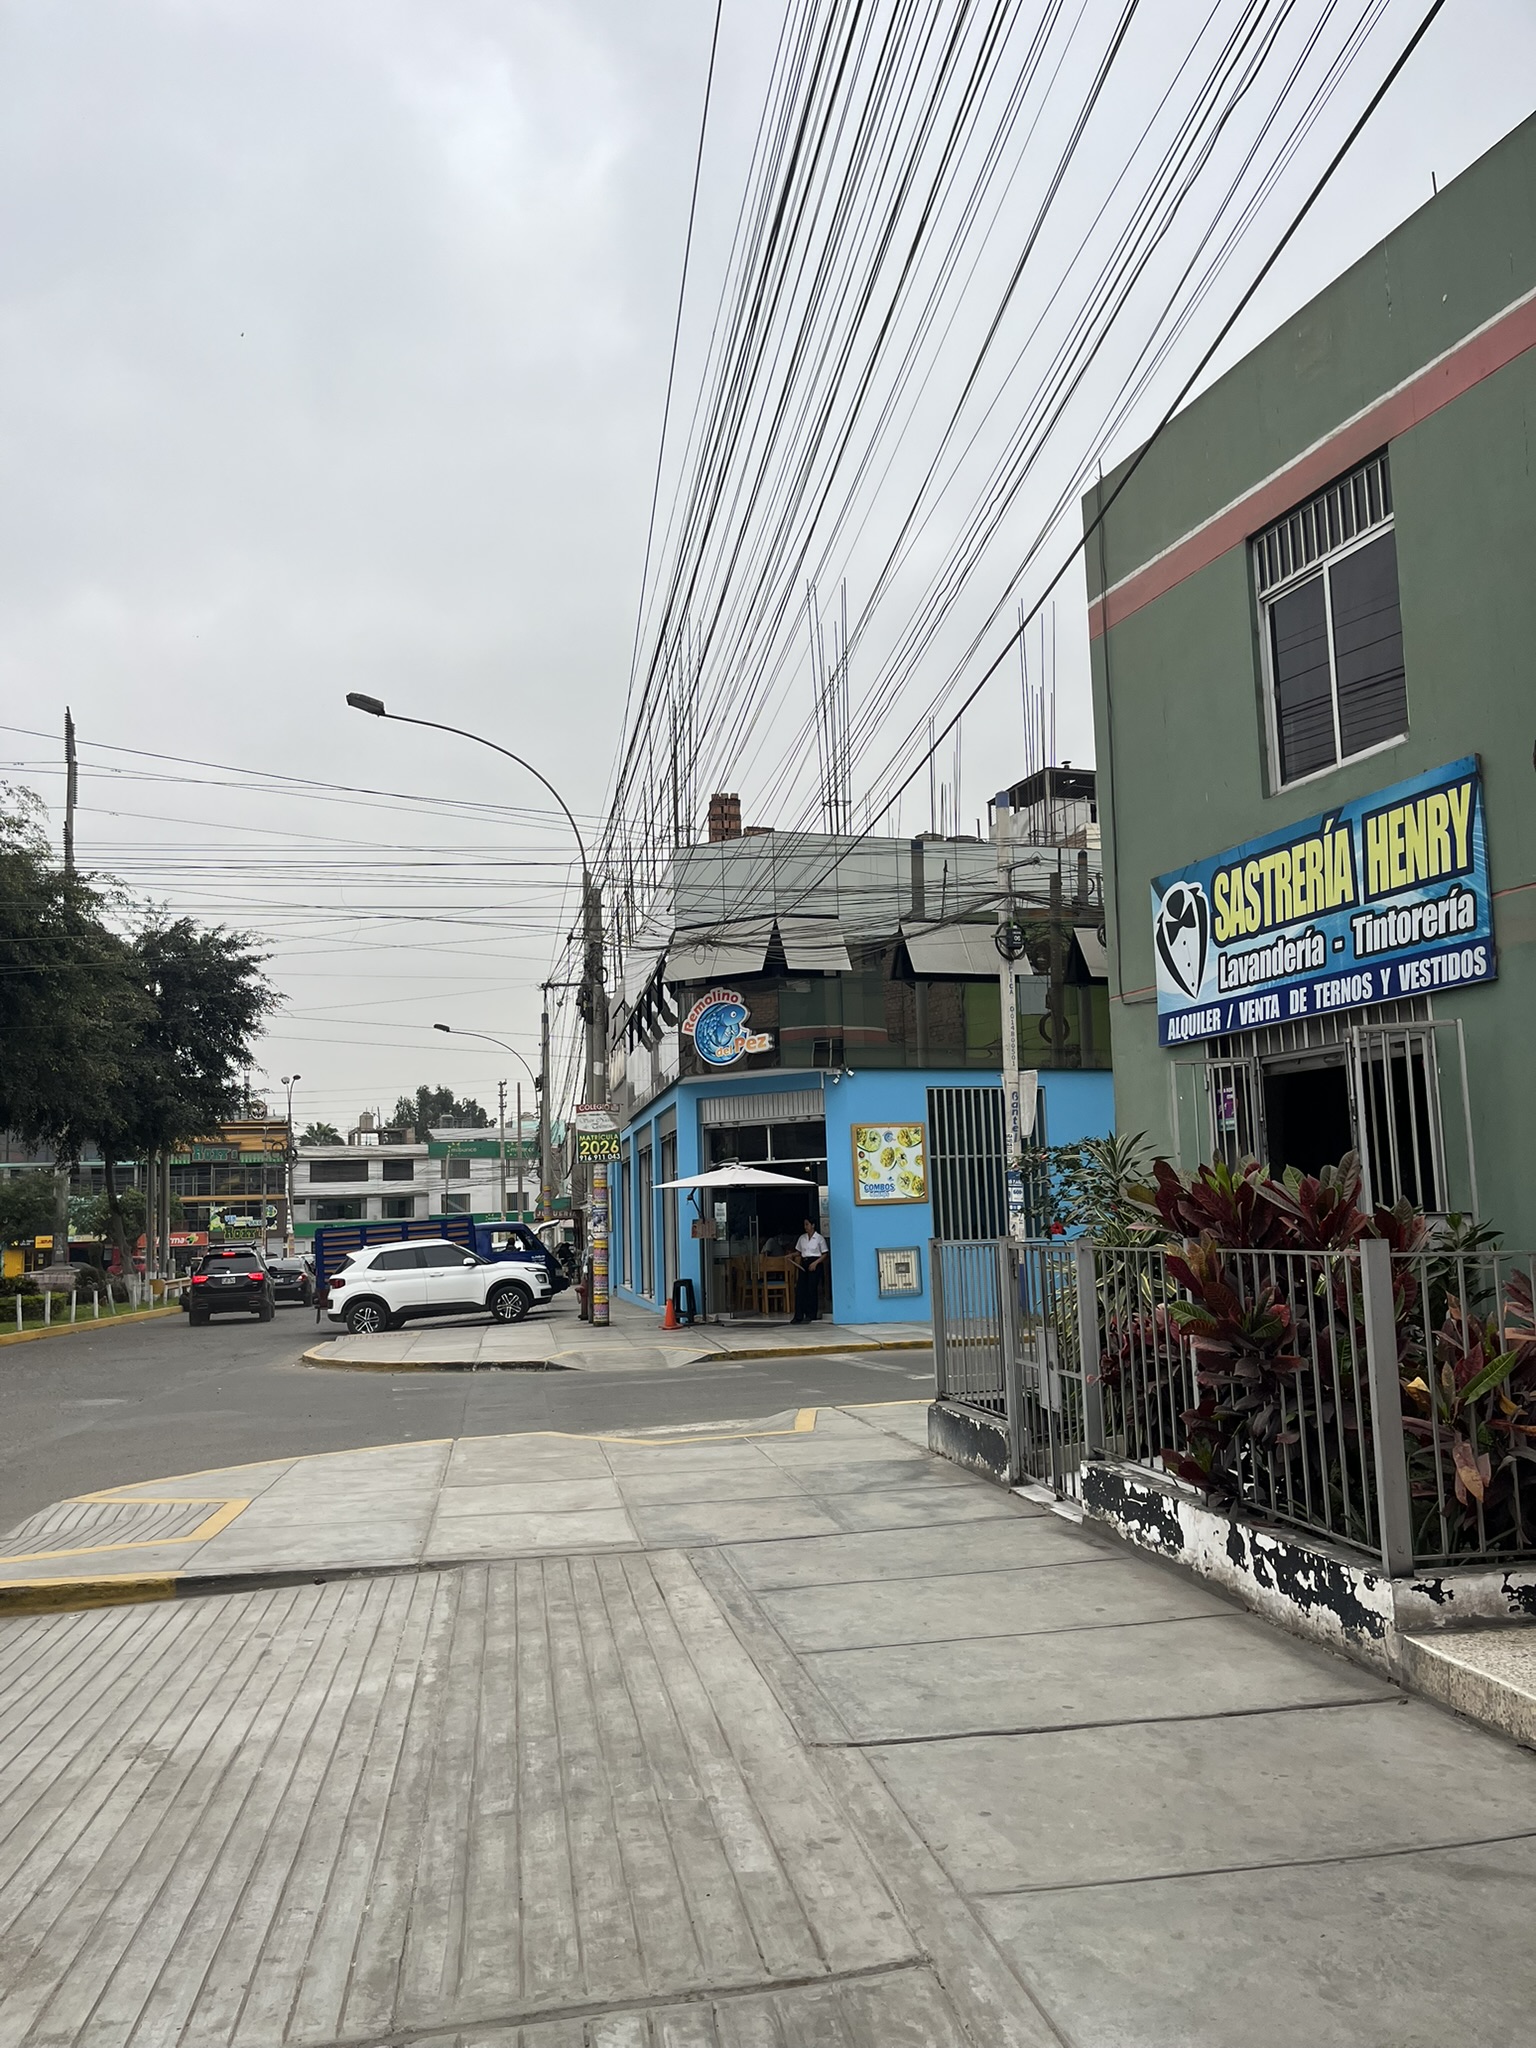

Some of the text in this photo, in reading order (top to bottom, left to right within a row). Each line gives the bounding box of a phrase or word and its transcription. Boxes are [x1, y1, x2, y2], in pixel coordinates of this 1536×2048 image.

[1213, 781, 1473, 942] SASTRERÍA HENRY
[1219, 929, 1325, 990] Lavandería
[1352, 887, 1475, 956] Tintorería
[1167, 1007, 1221, 1041] ALQUILER
[1239, 993, 1281, 1026] VENTA
[1289, 986, 1308, 1015] DE
[1313, 972, 1374, 1010] TERNOS
[1380, 967, 1392, 996] Y
[1398, 945, 1488, 992] VESTIDOS
[683, 990, 739, 1033] Remolino
[716, 1035, 768, 1058] del Pez
[578, 1103, 610, 1111] COLEGIO
[579, 1139, 620, 1155] 2026
[579, 1152, 621, 1162] 916 911 043
[864, 1183, 896, 1193] COMBOS
